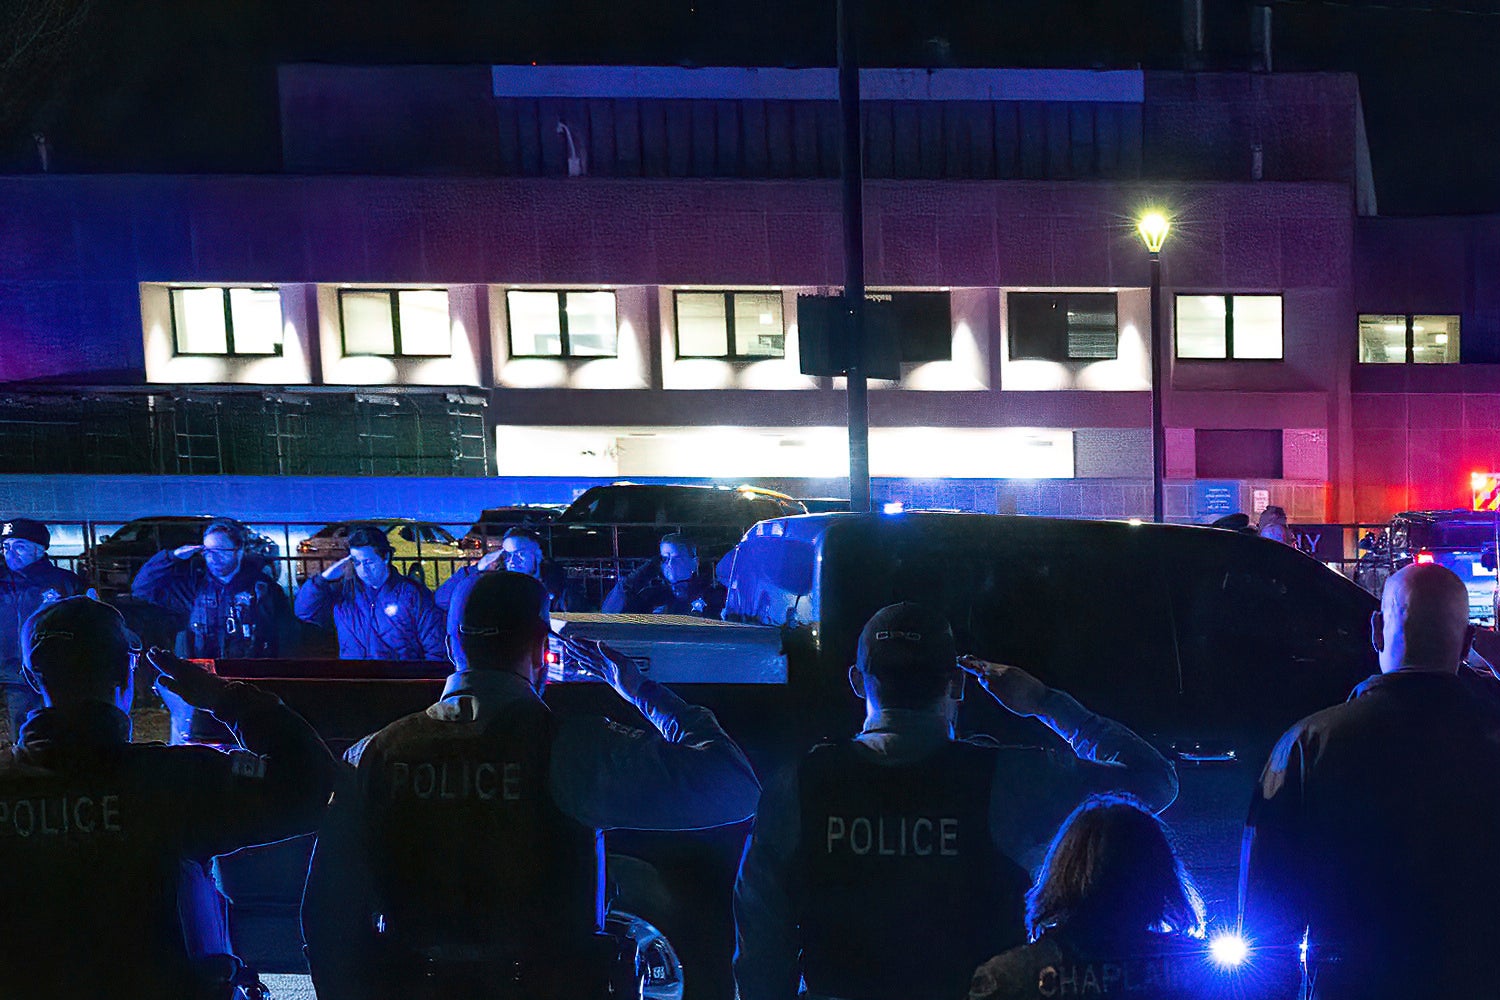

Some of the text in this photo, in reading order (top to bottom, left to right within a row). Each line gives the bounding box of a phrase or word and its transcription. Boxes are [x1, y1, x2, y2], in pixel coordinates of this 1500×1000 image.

[391, 761, 521, 800] POLICE
[0, 794, 121, 837] POLICE
[827, 815, 959, 856] POLICE
